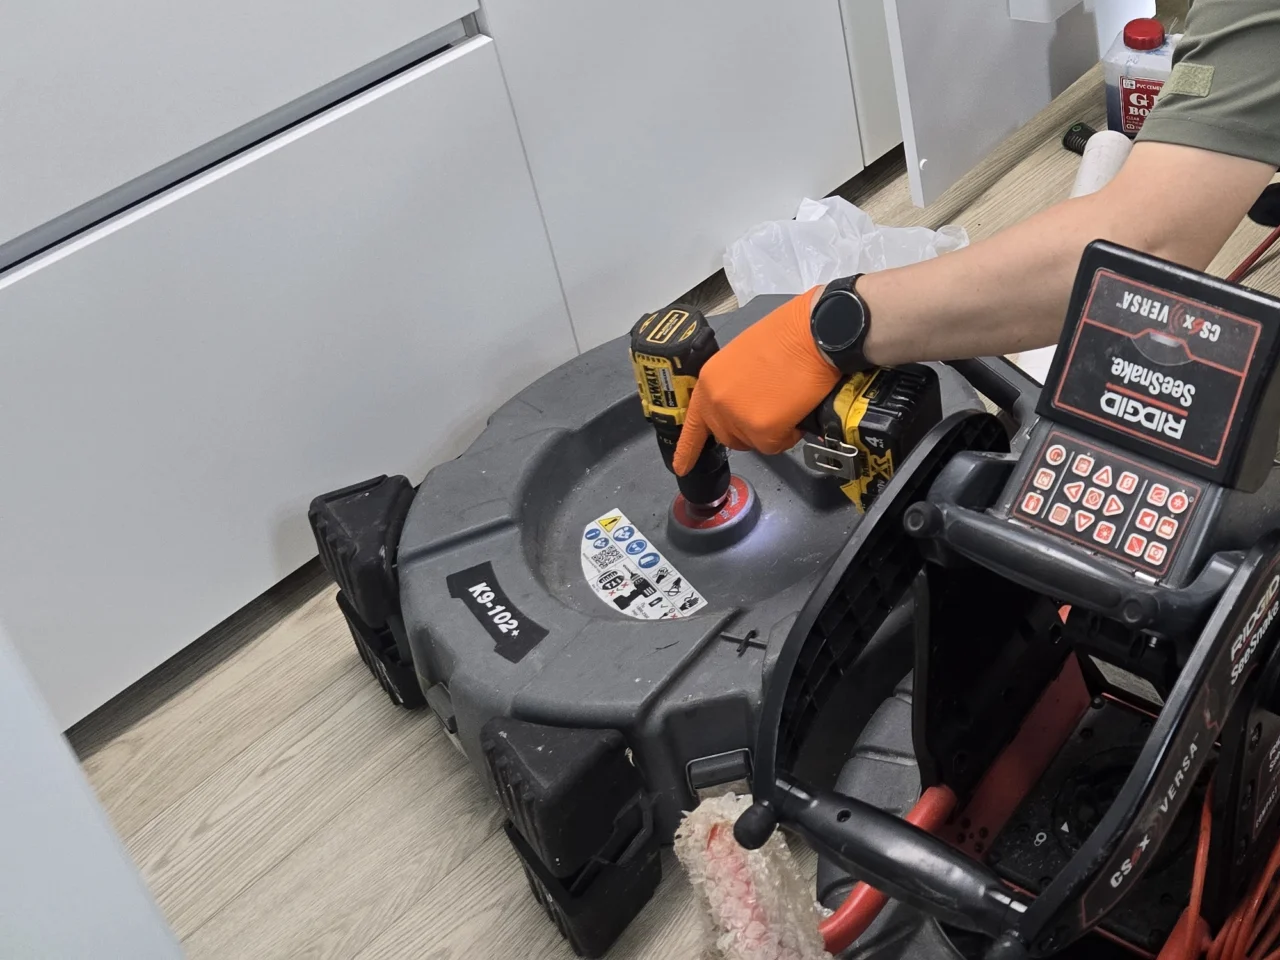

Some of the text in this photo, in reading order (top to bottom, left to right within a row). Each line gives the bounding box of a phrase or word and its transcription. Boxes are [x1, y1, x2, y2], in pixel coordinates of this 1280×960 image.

[1128, 106, 1153, 117] BO
[1121, 290, 1170, 324] VERSA
[1099, 390, 1188, 441] RIDGID
[864, 435, 880, 449] 4
[1229, 573, 1280, 663] RIDGID
[1230, 600, 1280, 687] SeeSnake
[1158, 741, 1199, 815] VERSA
